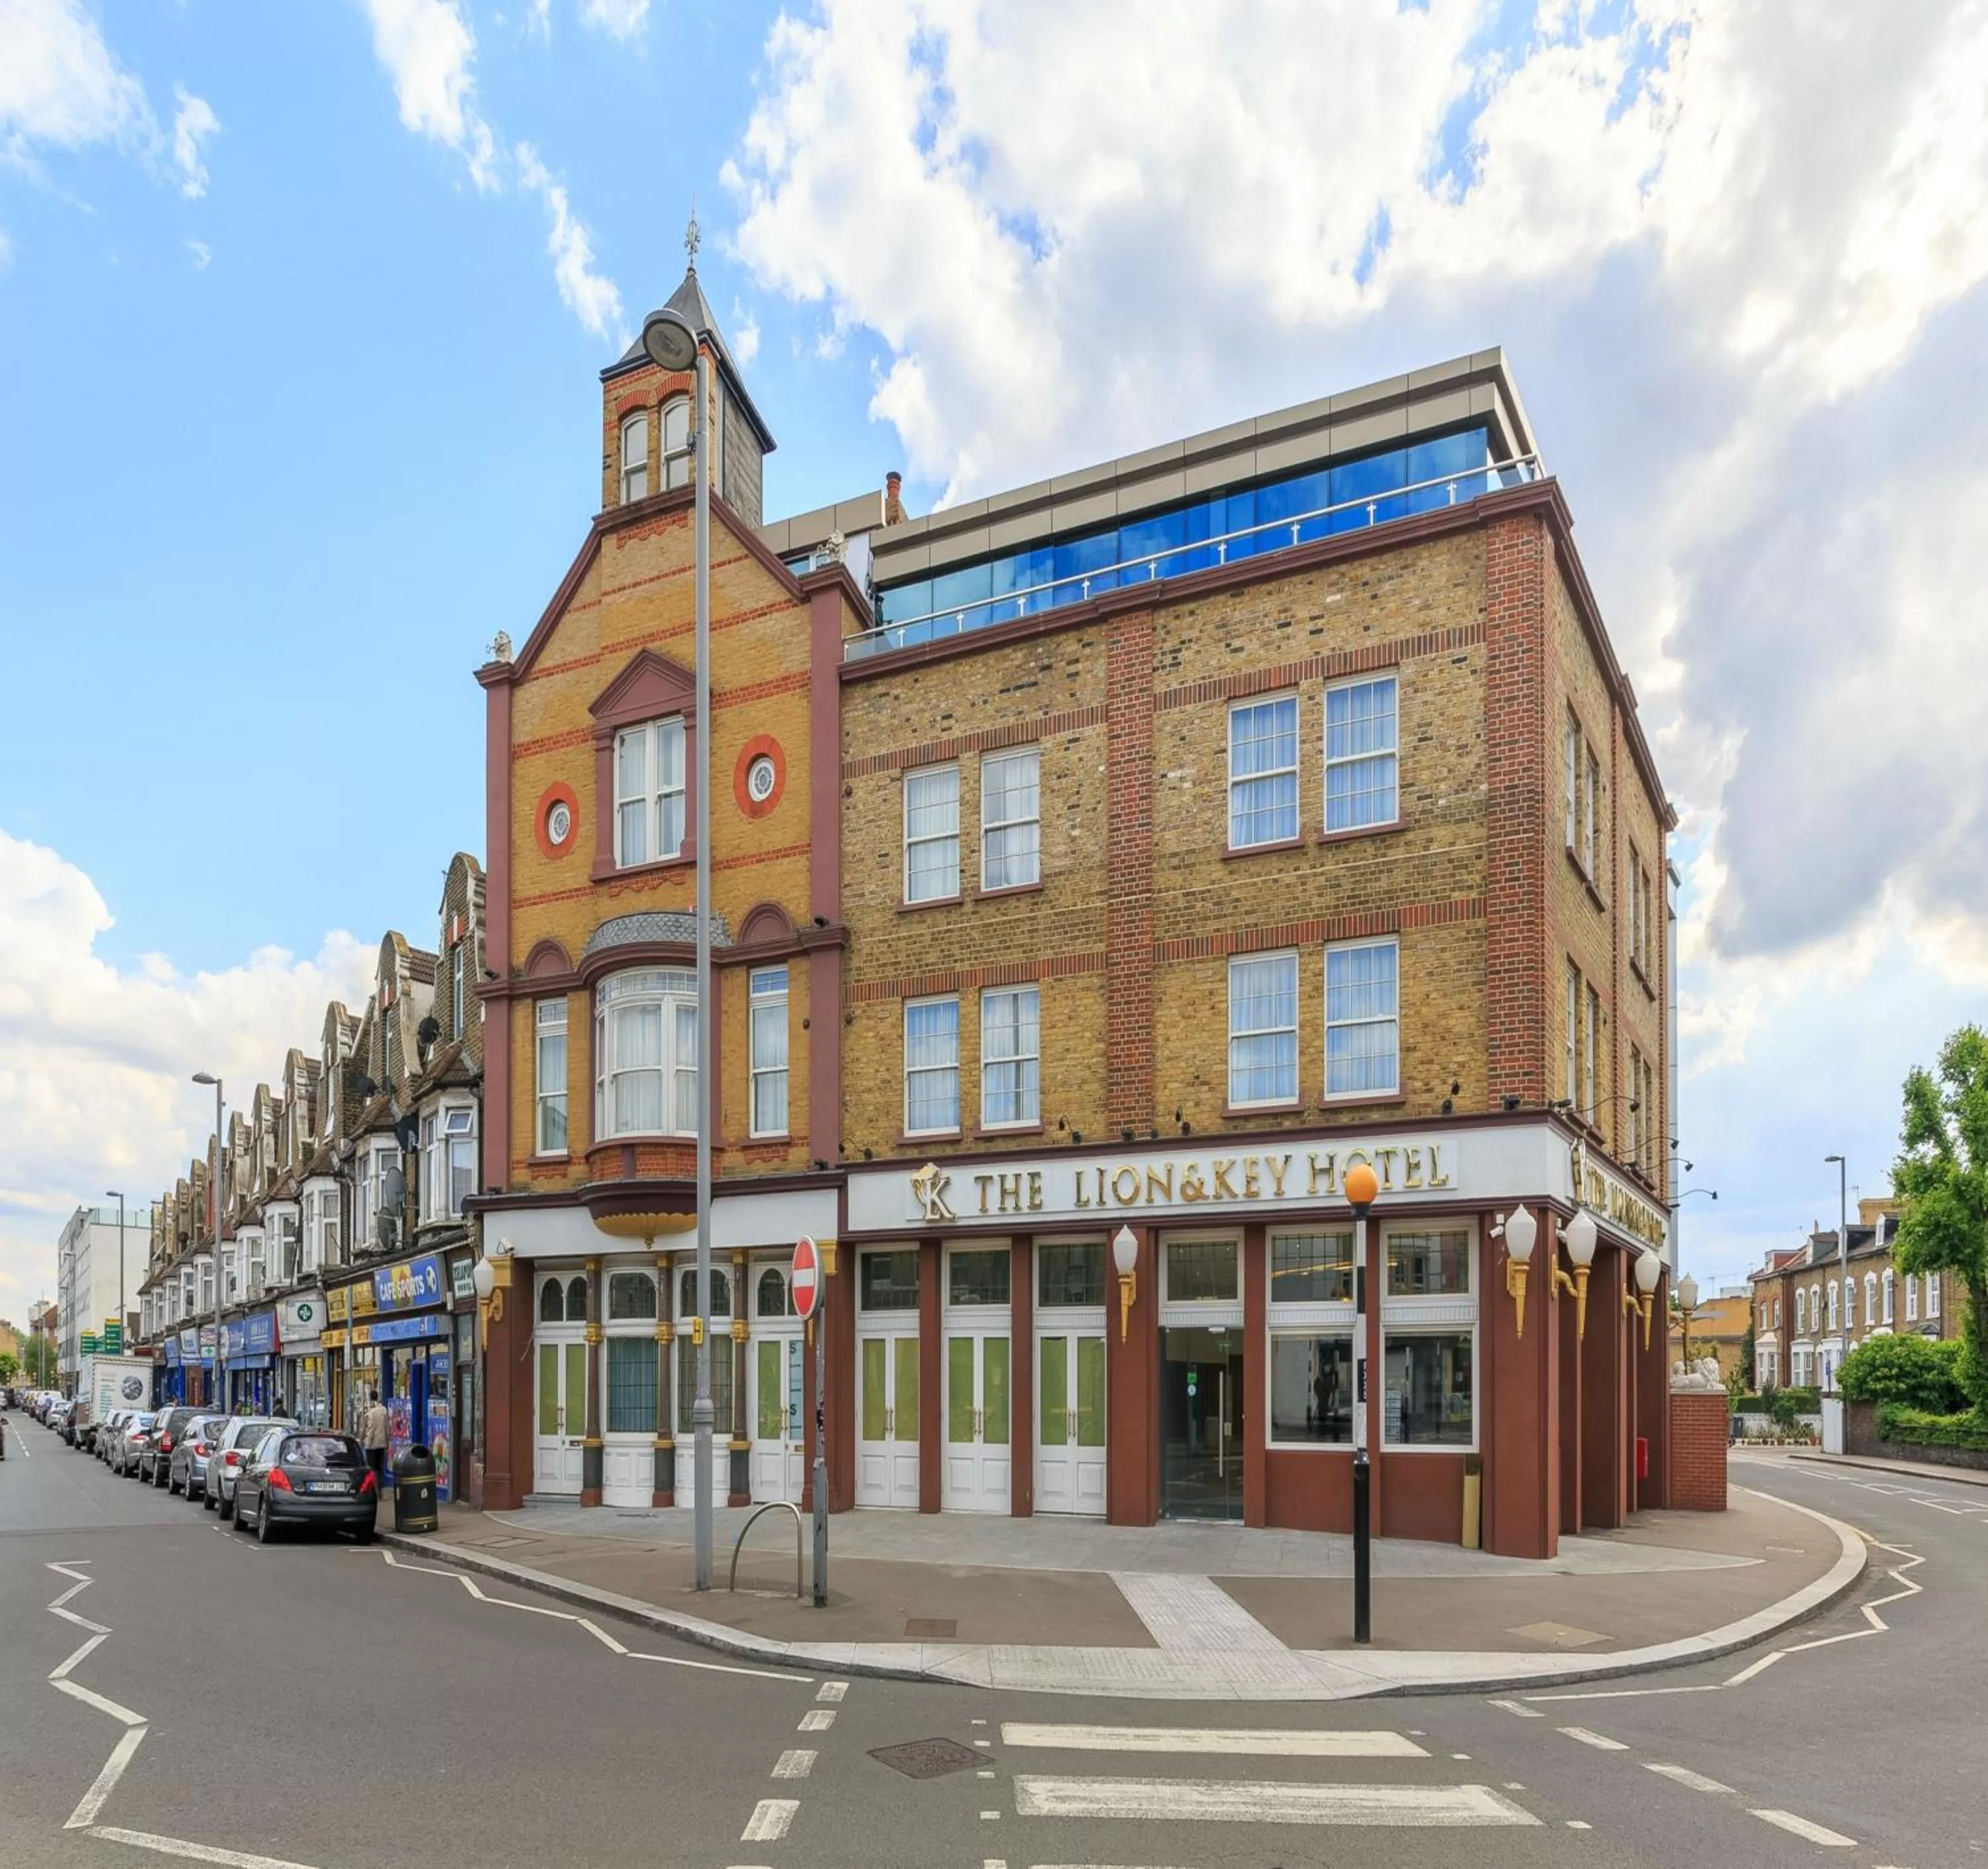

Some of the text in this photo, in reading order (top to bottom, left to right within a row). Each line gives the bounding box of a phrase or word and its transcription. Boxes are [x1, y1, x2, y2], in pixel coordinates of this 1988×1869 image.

[973, 1171, 1043, 1213] THE
[1074, 1153, 1293, 1208] LION&KEY
[379, 1281, 396, 1302] CAFE
[397, 1274, 425, 1299] SPORTS
